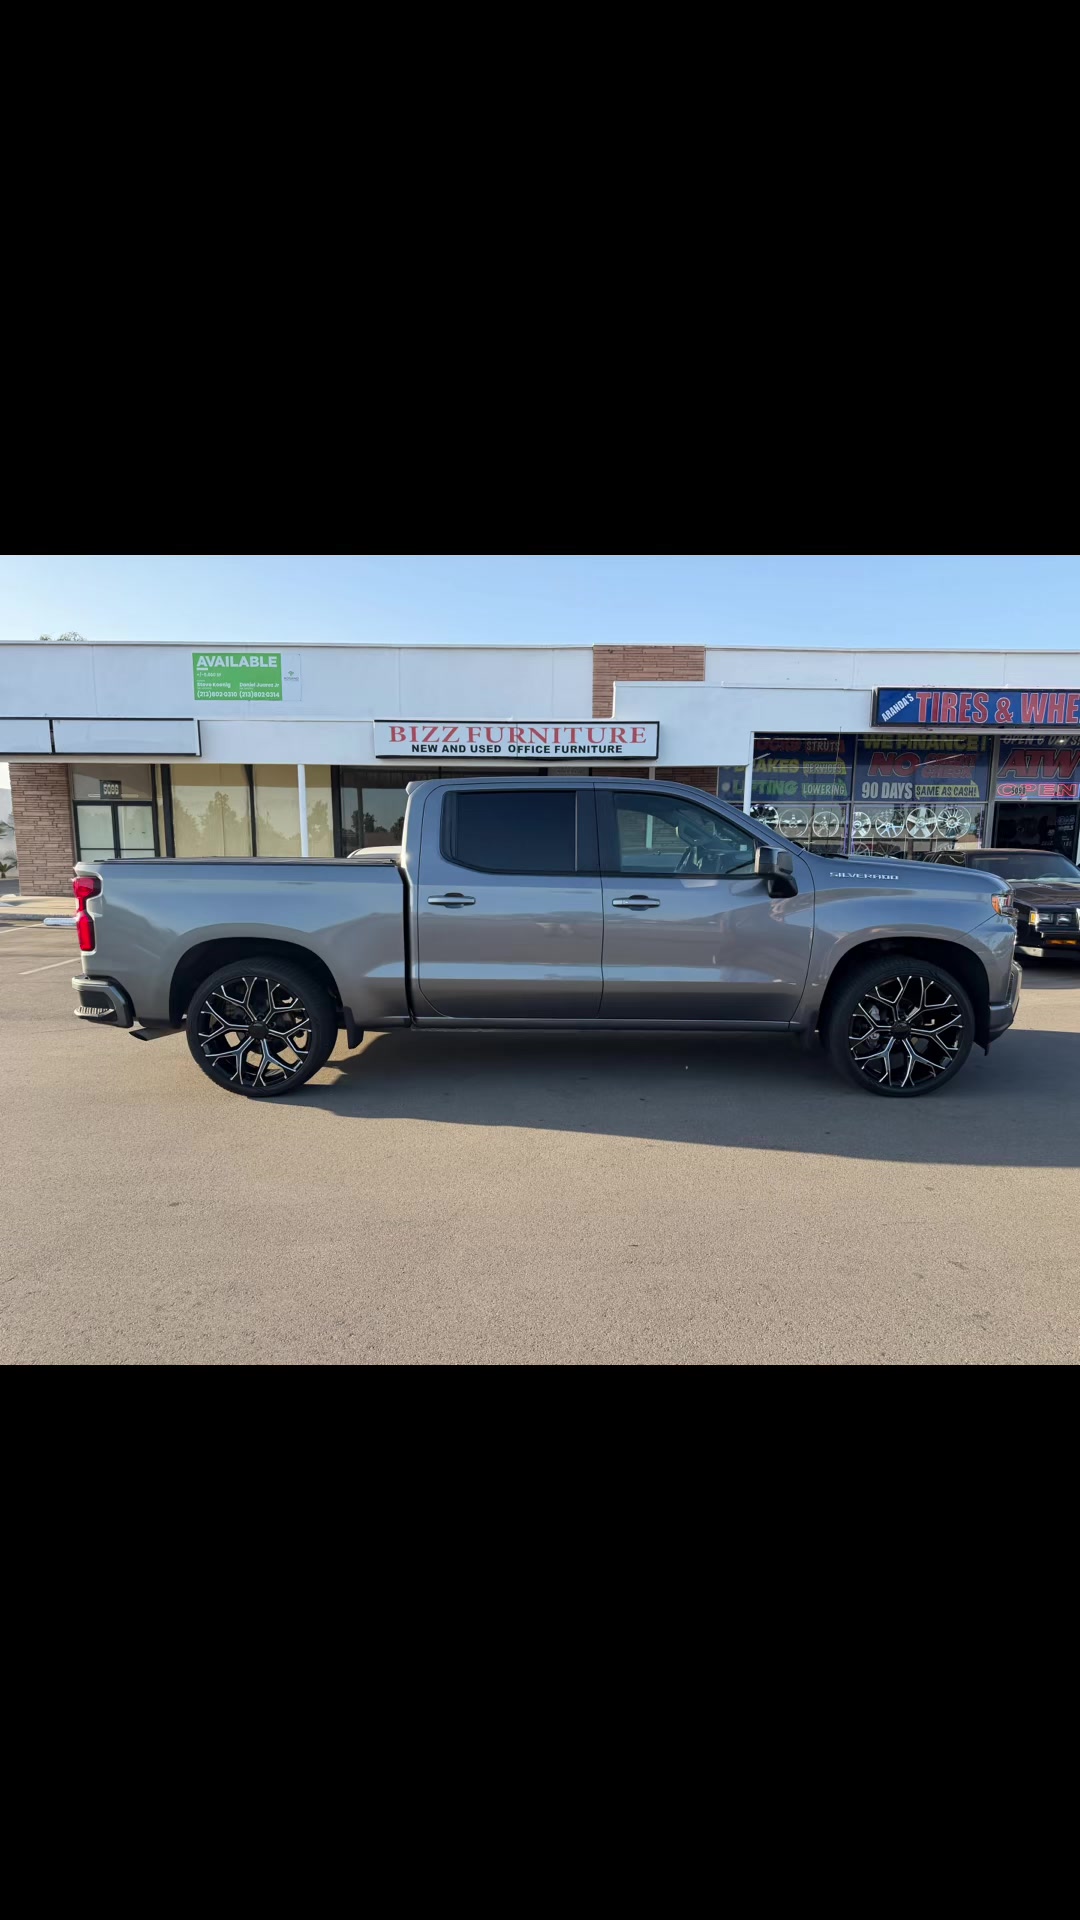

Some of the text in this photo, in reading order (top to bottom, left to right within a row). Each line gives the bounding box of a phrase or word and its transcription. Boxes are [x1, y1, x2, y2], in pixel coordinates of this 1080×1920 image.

[196, 655, 278, 668] AVAILABLE
[881, 693, 915, 722] ARANDA'S
[915, 691, 1080, 724] TIRES & WHE
[388, 725, 647, 744] BIZZ FURNITURE
[863, 734, 890, 750] WE
[411, 744, 623, 754] NEW AND USED OFFICE FURNITURE
[805, 740, 840, 752] STRUTS
[867, 751, 921, 777] NO
[732, 780, 845, 796] LFTING LOWERING
[861, 781, 977, 800] 90 DAYS SAME AS CASH!
[997, 783, 1078, 797] OPEN
[829, 872, 900, 880] SILVERADO
